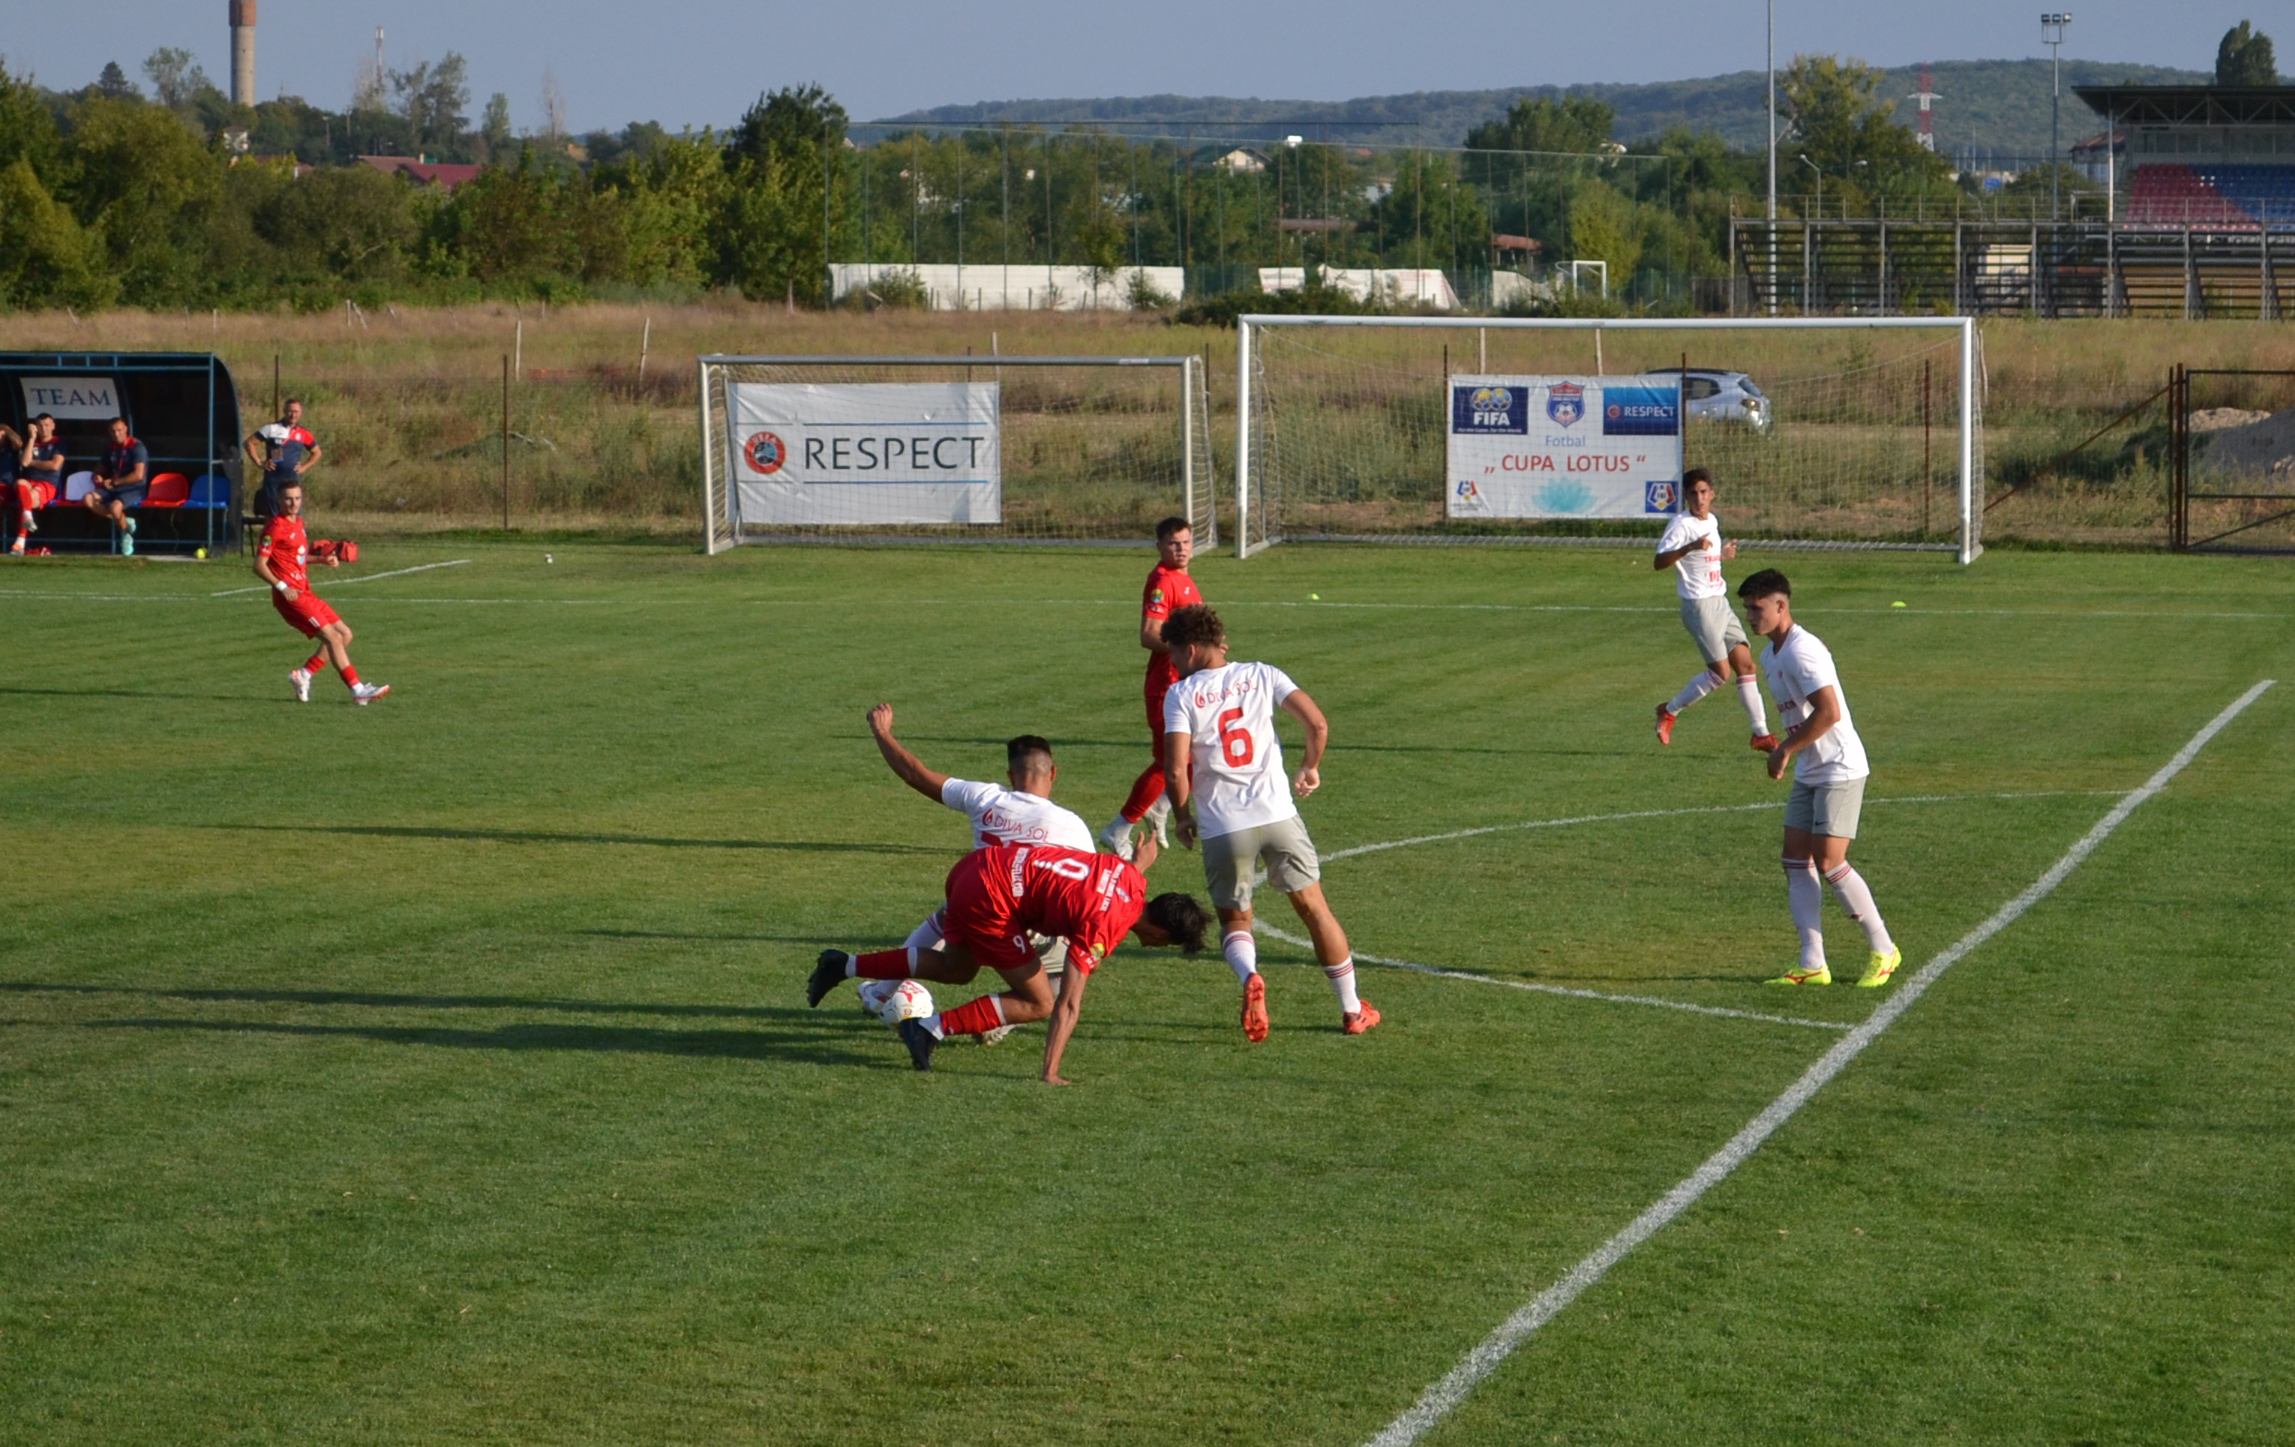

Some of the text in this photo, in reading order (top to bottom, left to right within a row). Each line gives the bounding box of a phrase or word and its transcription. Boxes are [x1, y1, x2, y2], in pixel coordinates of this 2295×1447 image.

[30, 387, 112, 407] TEAM
[1473, 412, 1510, 425] FIFA
[1624, 405, 1675, 418] RESPECT
[751, 432, 777, 443] UEFA
[1545, 435, 1586, 447] Fotbal
[804, 436, 985, 470] RESPECT
[1502, 454, 1555, 472] CUPA
[1566, 455, 1631, 472] LOTUS
[1218, 706, 1254, 768] 6
[994, 815, 1023, 835] DIVA
[1027, 826, 1049, 843] SOL
[1012, 934, 1026, 954] 9
